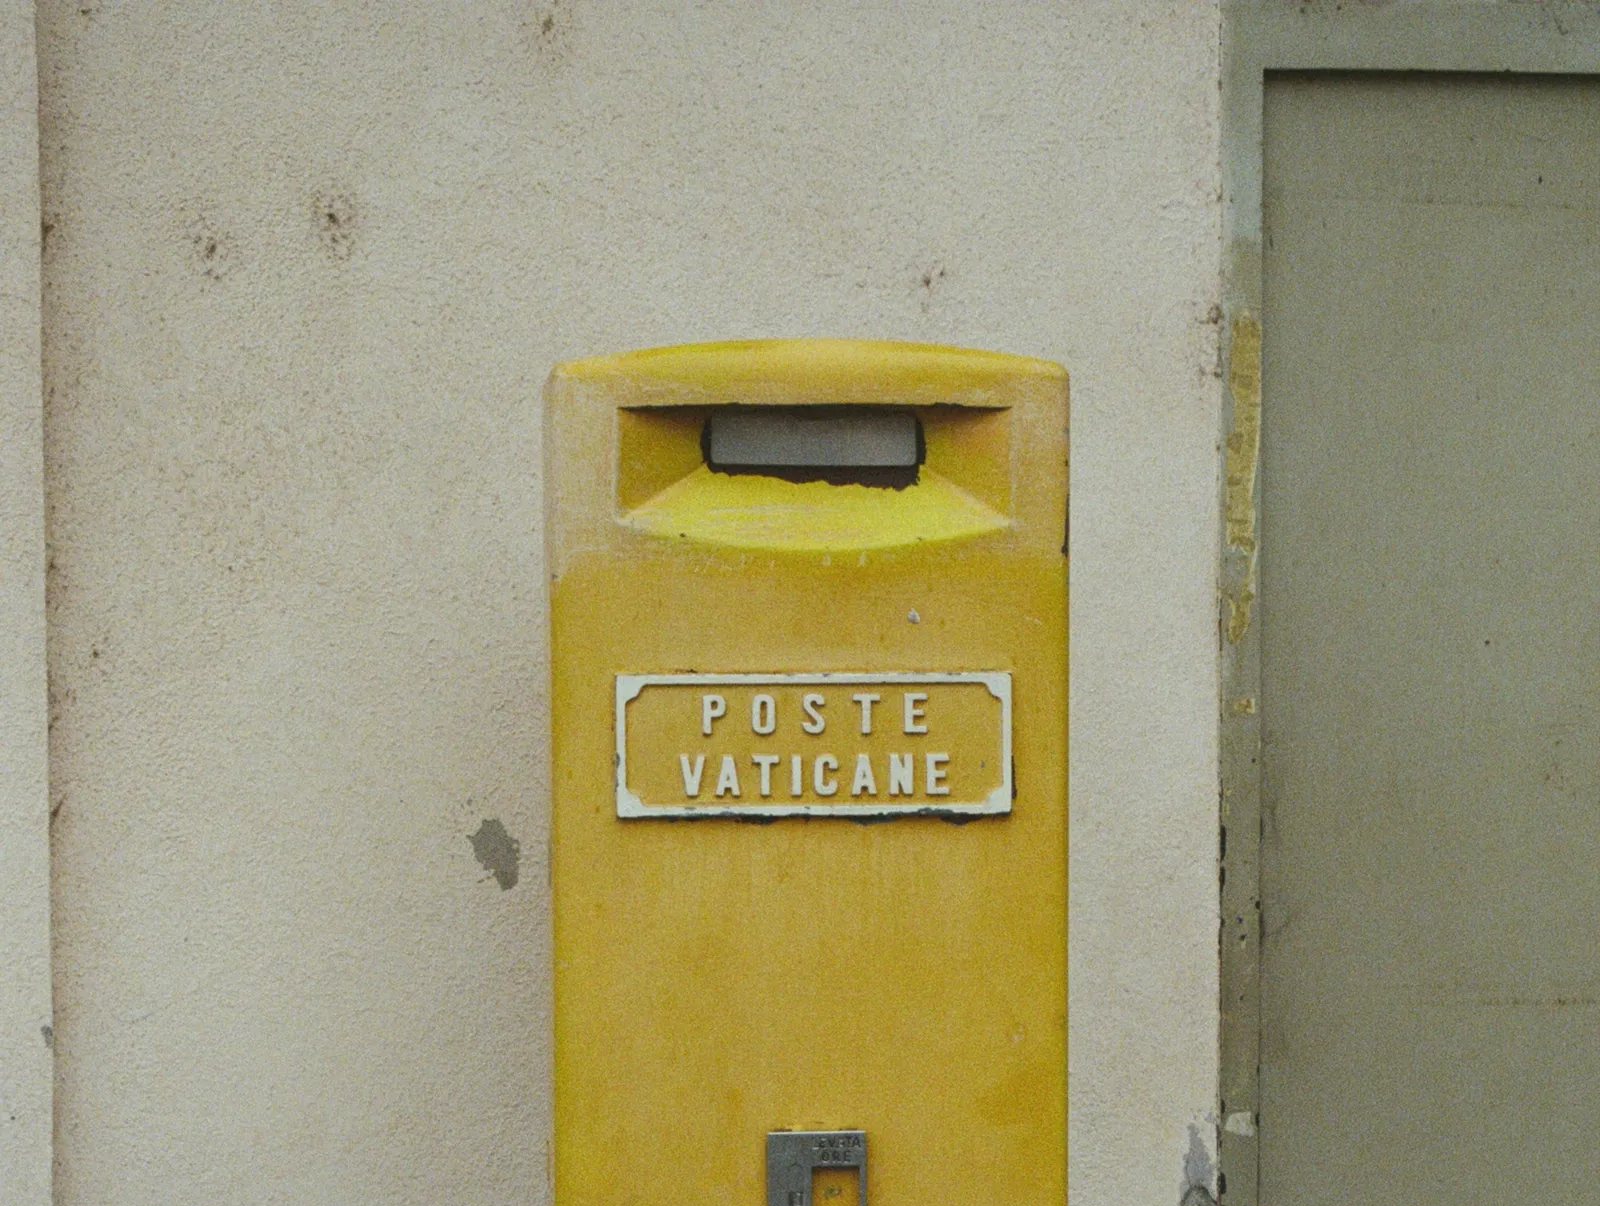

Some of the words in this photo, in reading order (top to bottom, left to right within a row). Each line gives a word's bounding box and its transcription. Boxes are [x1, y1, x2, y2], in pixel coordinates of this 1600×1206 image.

[702, 692, 929, 735] POSTE
[679, 752, 951, 797] VATICANE
[821, 1150, 852, 1163] ORE
